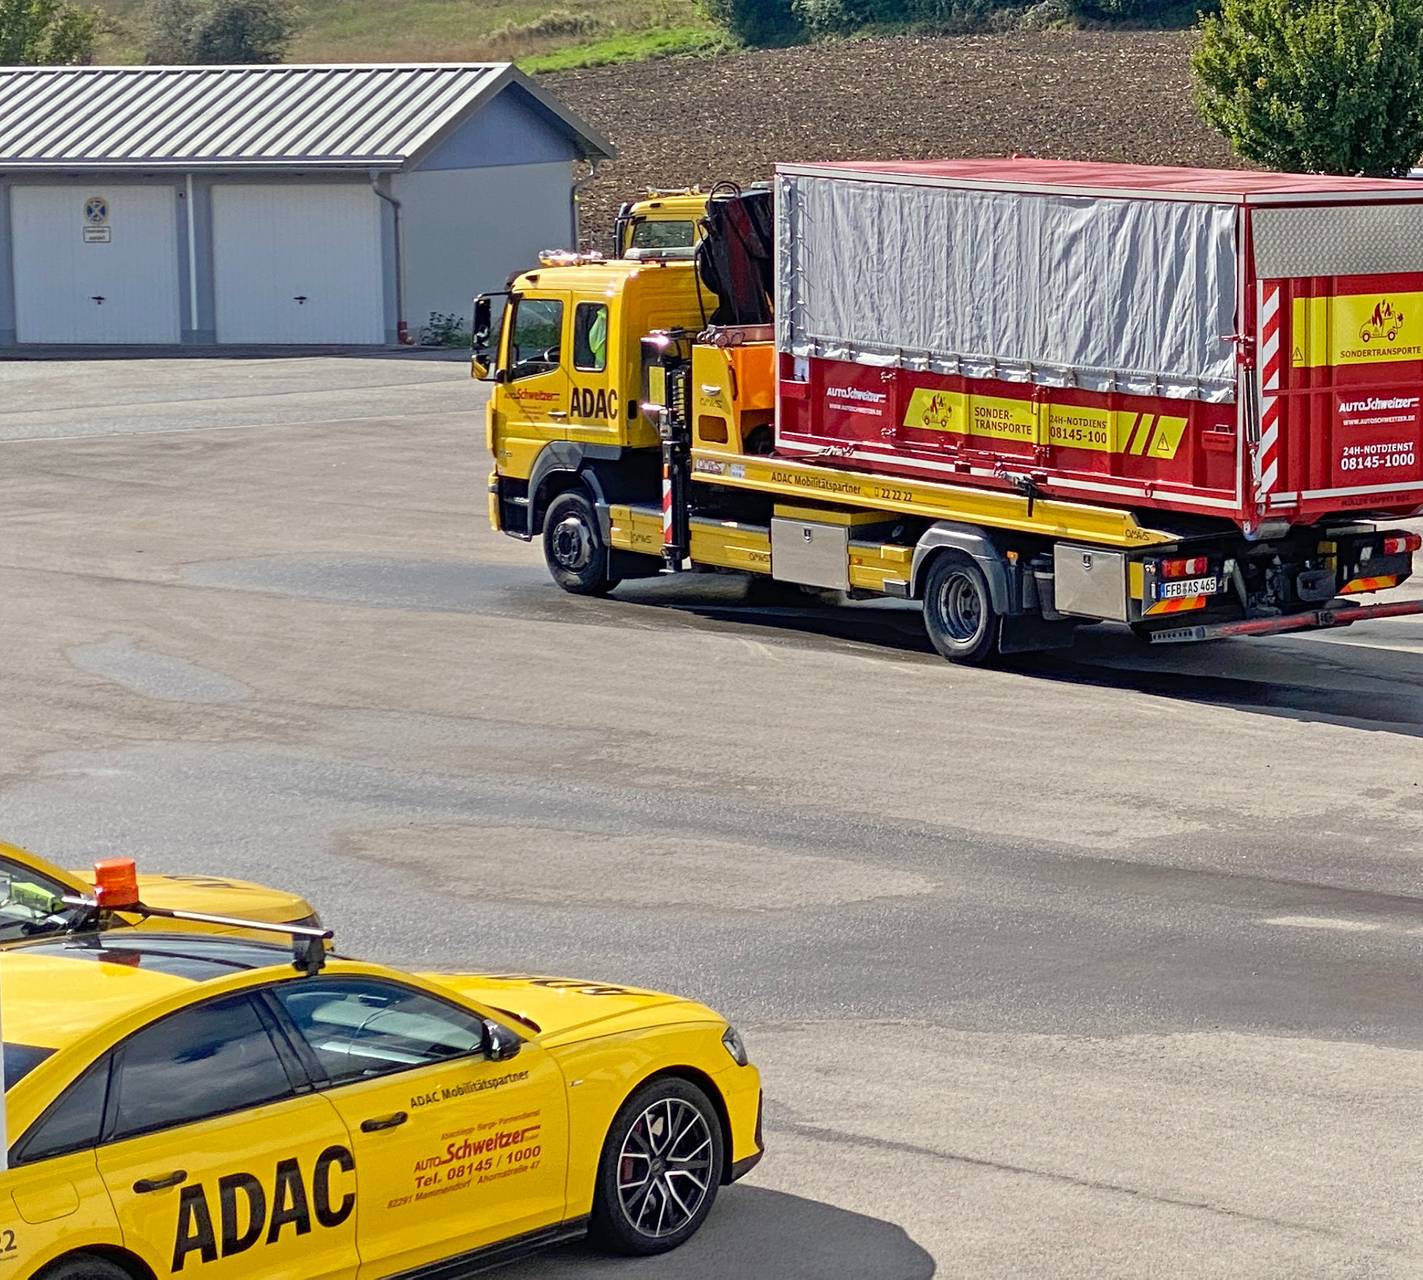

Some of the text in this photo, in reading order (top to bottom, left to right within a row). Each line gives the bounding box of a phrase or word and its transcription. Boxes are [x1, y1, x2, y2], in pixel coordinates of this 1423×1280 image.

[1339, 345, 1422, 358] SONDERTRANSPORTE
[570, 387, 618, 420] ADAC
[974, 406, 1014, 421] SONDER-
[975, 419, 1032, 435] TRANSPORTE
[1050, 415, 1108, 430] 24H-NOTDIENS
[1050, 426, 1107, 444] 08145-100
[1343, 441, 1414, 456] 24H-NOTDIENST
[1340, 453, 1415, 470] 08145-1000
[771, 471, 794, 484] ADAC
[1165, 578, 1216, 597] FFB AS 465
[410, 1070, 529, 1108] ADAC Mobilitätspartner
[415, 1172, 442, 1189] Tel.
[447, 1158, 493, 1180] 08145
[506, 1145, 541, 1164] 1000
[171, 1145, 356, 1273] ADAC
[0, 1229, 17, 1254] 2
